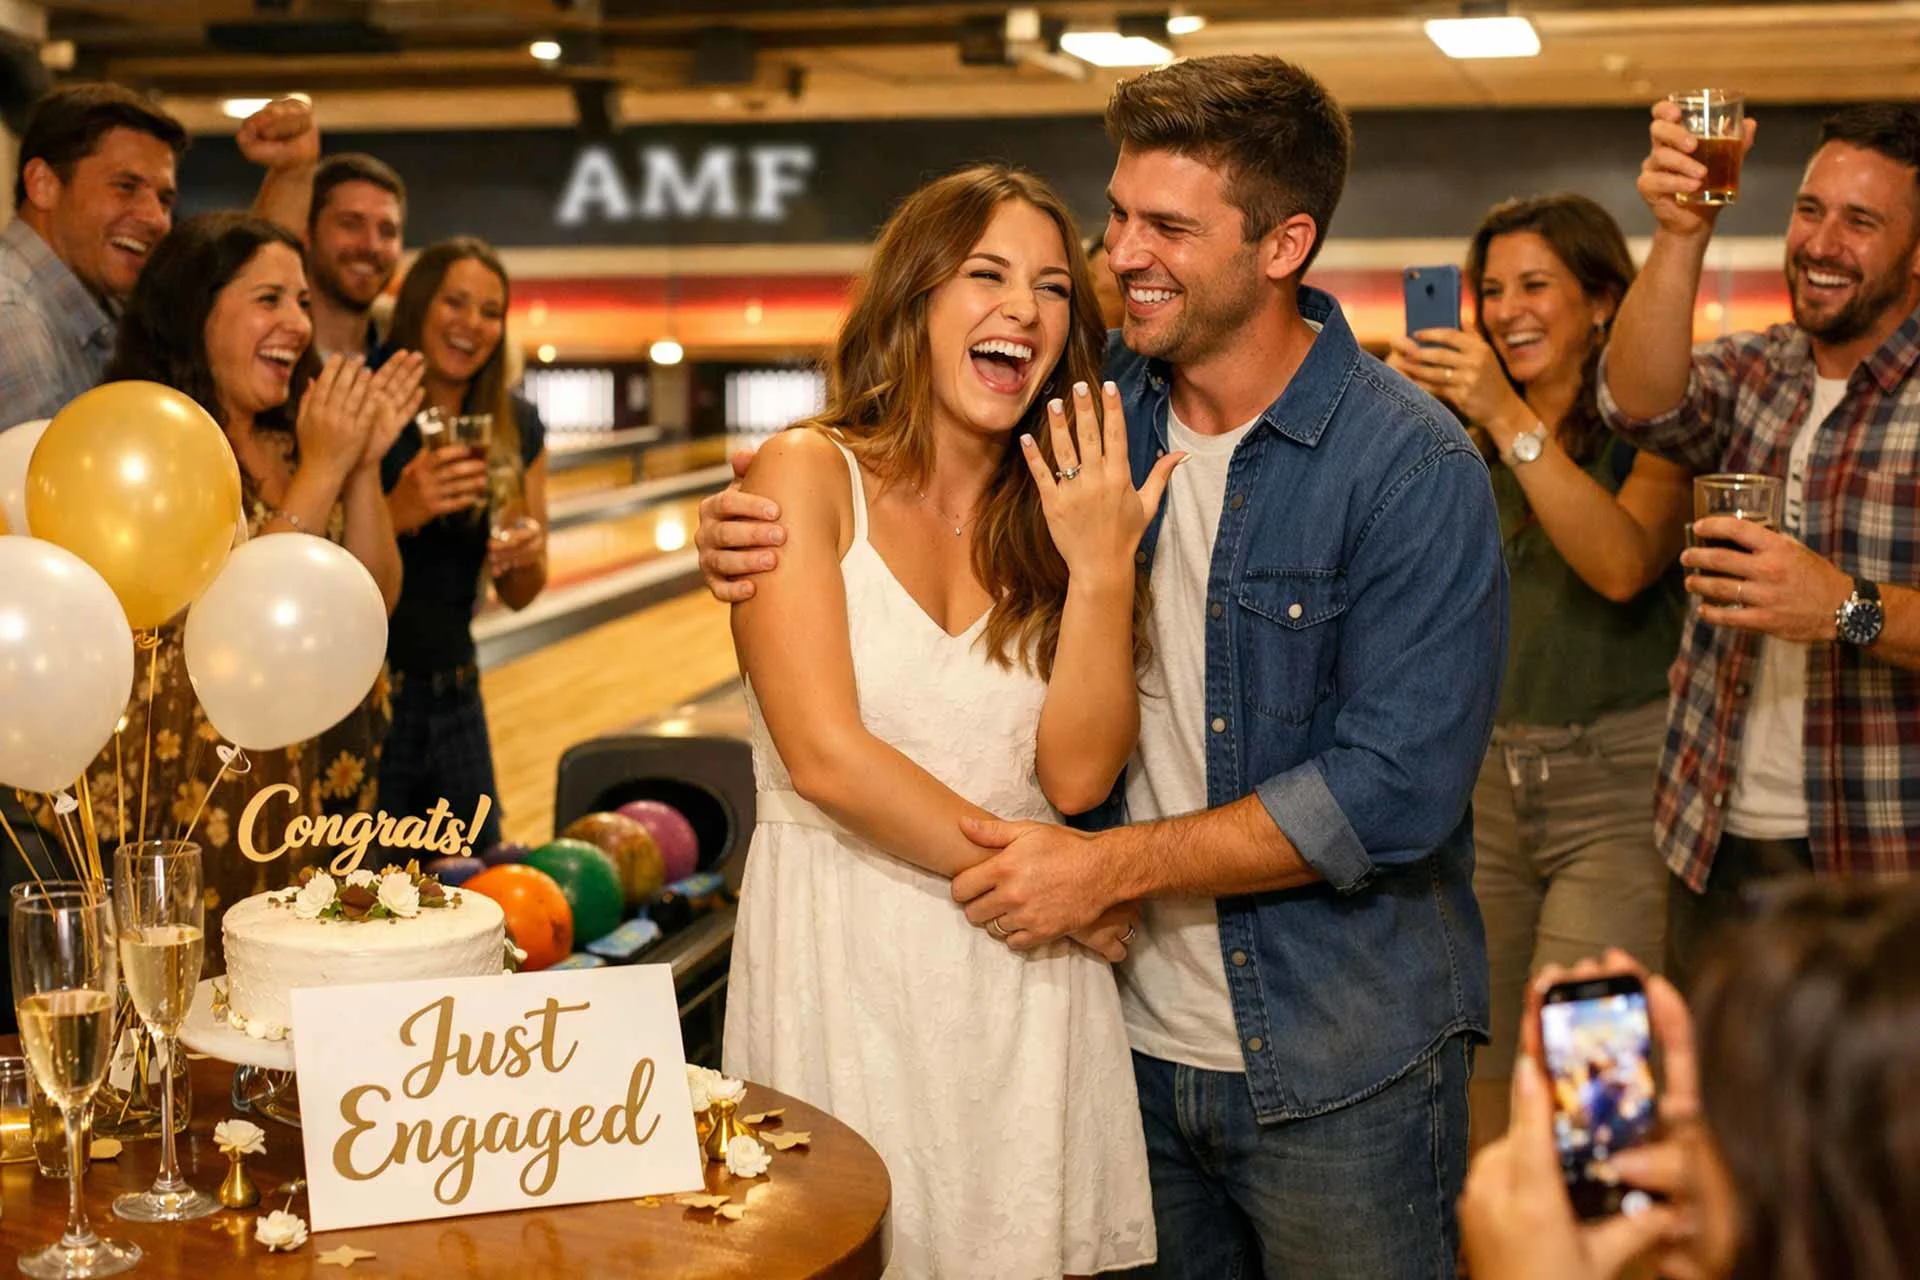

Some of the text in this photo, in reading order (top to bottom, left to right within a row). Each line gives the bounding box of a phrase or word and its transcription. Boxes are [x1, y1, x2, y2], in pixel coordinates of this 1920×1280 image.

[556, 146, 814, 223] AMF
[238, 783, 492, 877] Congrats!
[400, 996, 591, 1099] Just
[332, 1057, 661, 1206] Engaged
